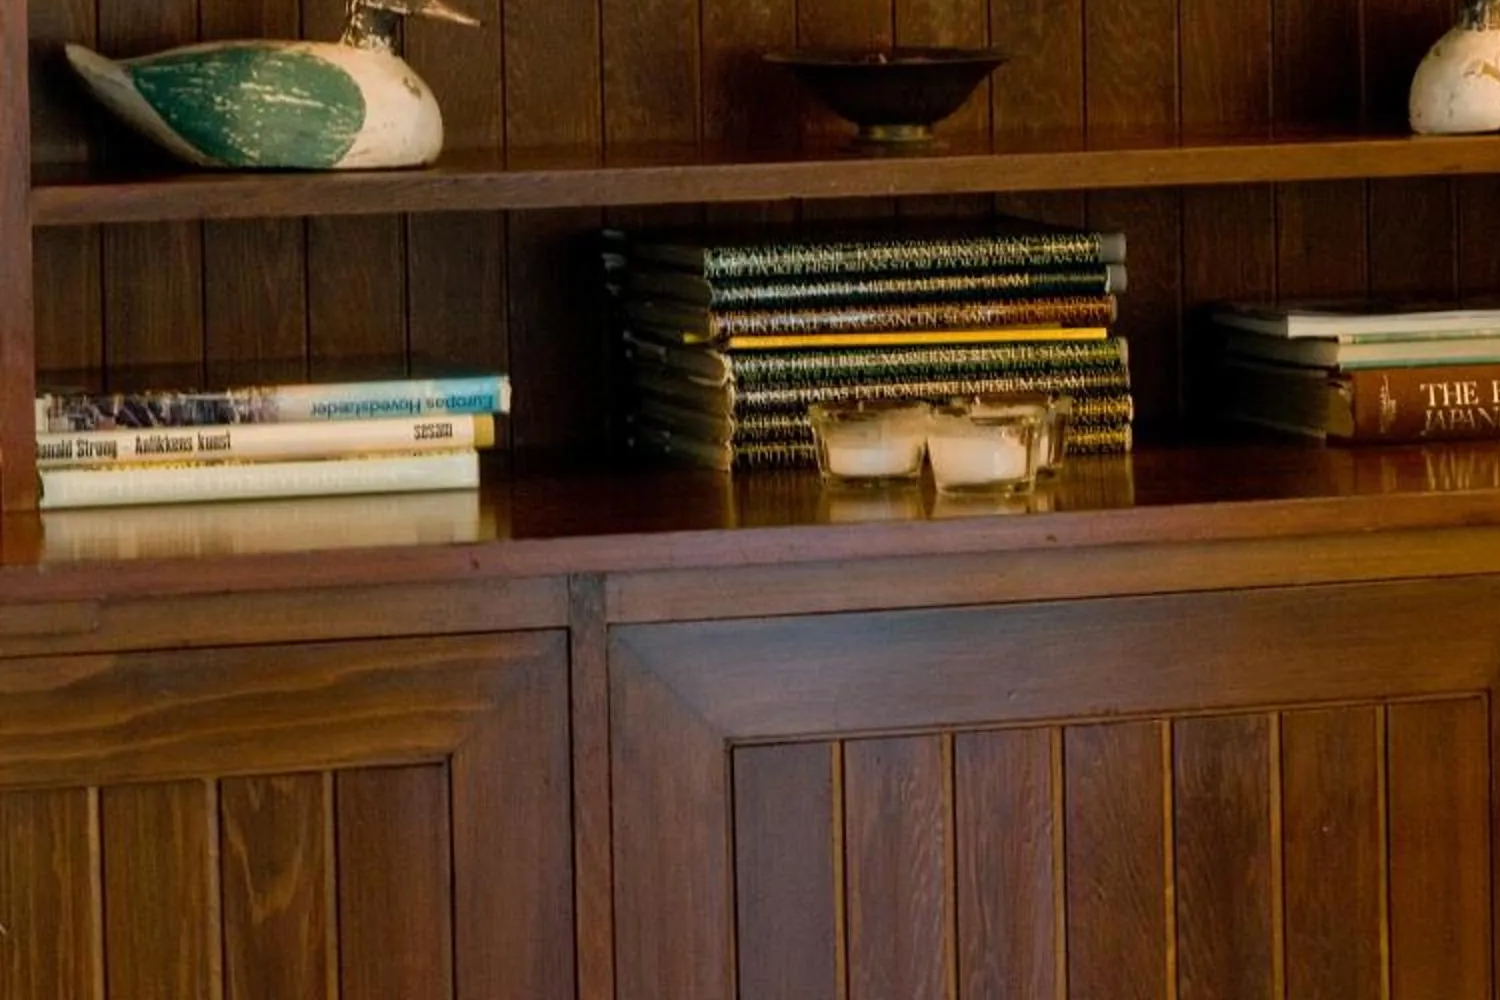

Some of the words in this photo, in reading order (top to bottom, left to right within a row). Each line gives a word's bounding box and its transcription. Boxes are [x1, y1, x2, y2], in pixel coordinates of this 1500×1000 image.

[425, 394, 494, 410] Europas
[1419, 381, 1479, 407] THE
[413, 423, 453, 440] sesam
[36, 440, 73, 460] onald
[76, 438, 118, 458] Strong
[198, 431, 231, 450] kunst
